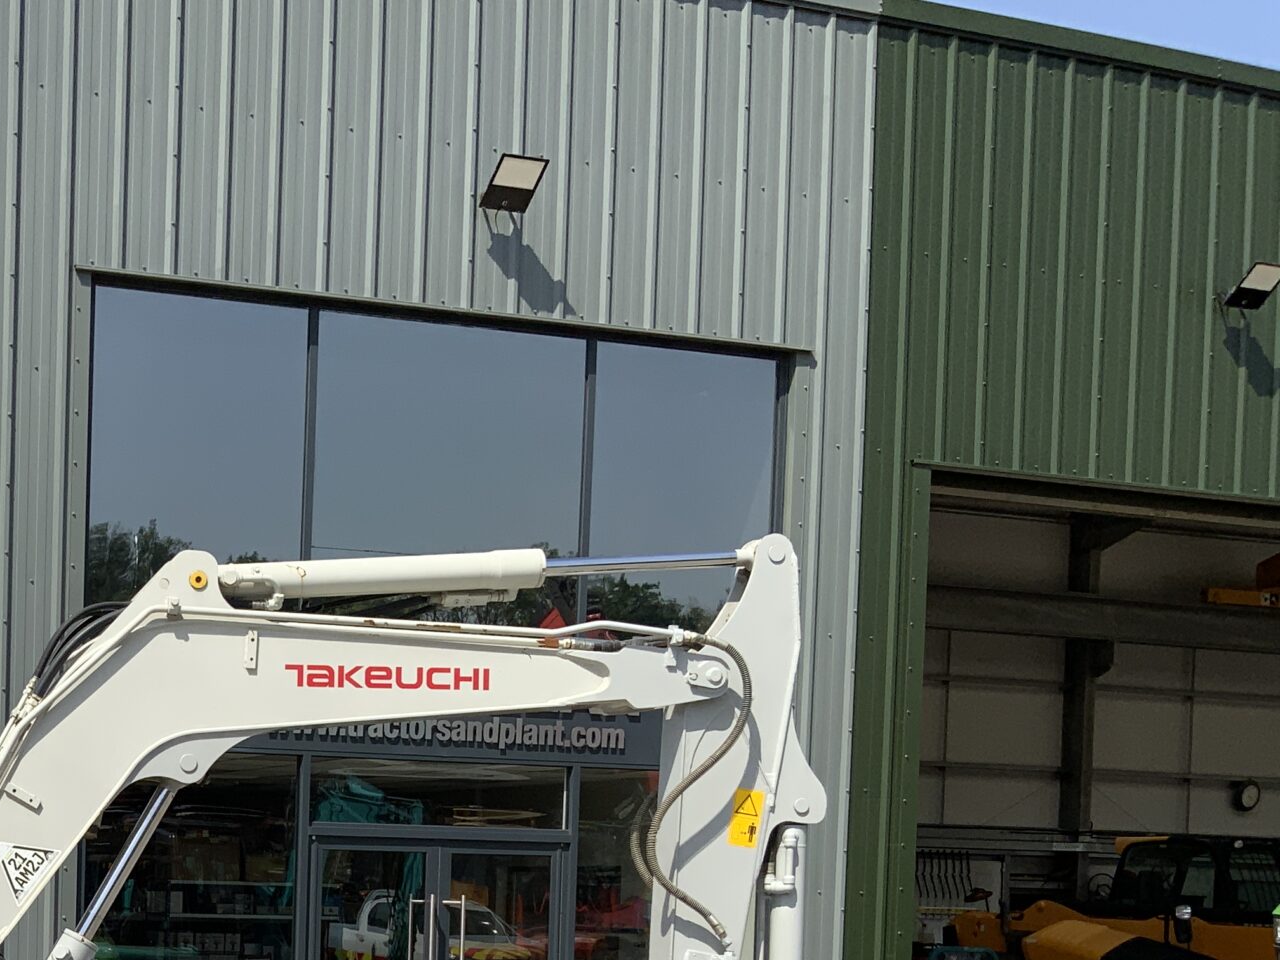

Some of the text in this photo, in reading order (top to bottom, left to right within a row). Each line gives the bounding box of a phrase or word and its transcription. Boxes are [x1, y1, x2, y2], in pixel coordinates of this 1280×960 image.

[285, 664, 490, 690] TAKEUCHI
[278, 714, 625, 749] .tractorsandplant.com
[8, 852, 27, 871] 21
